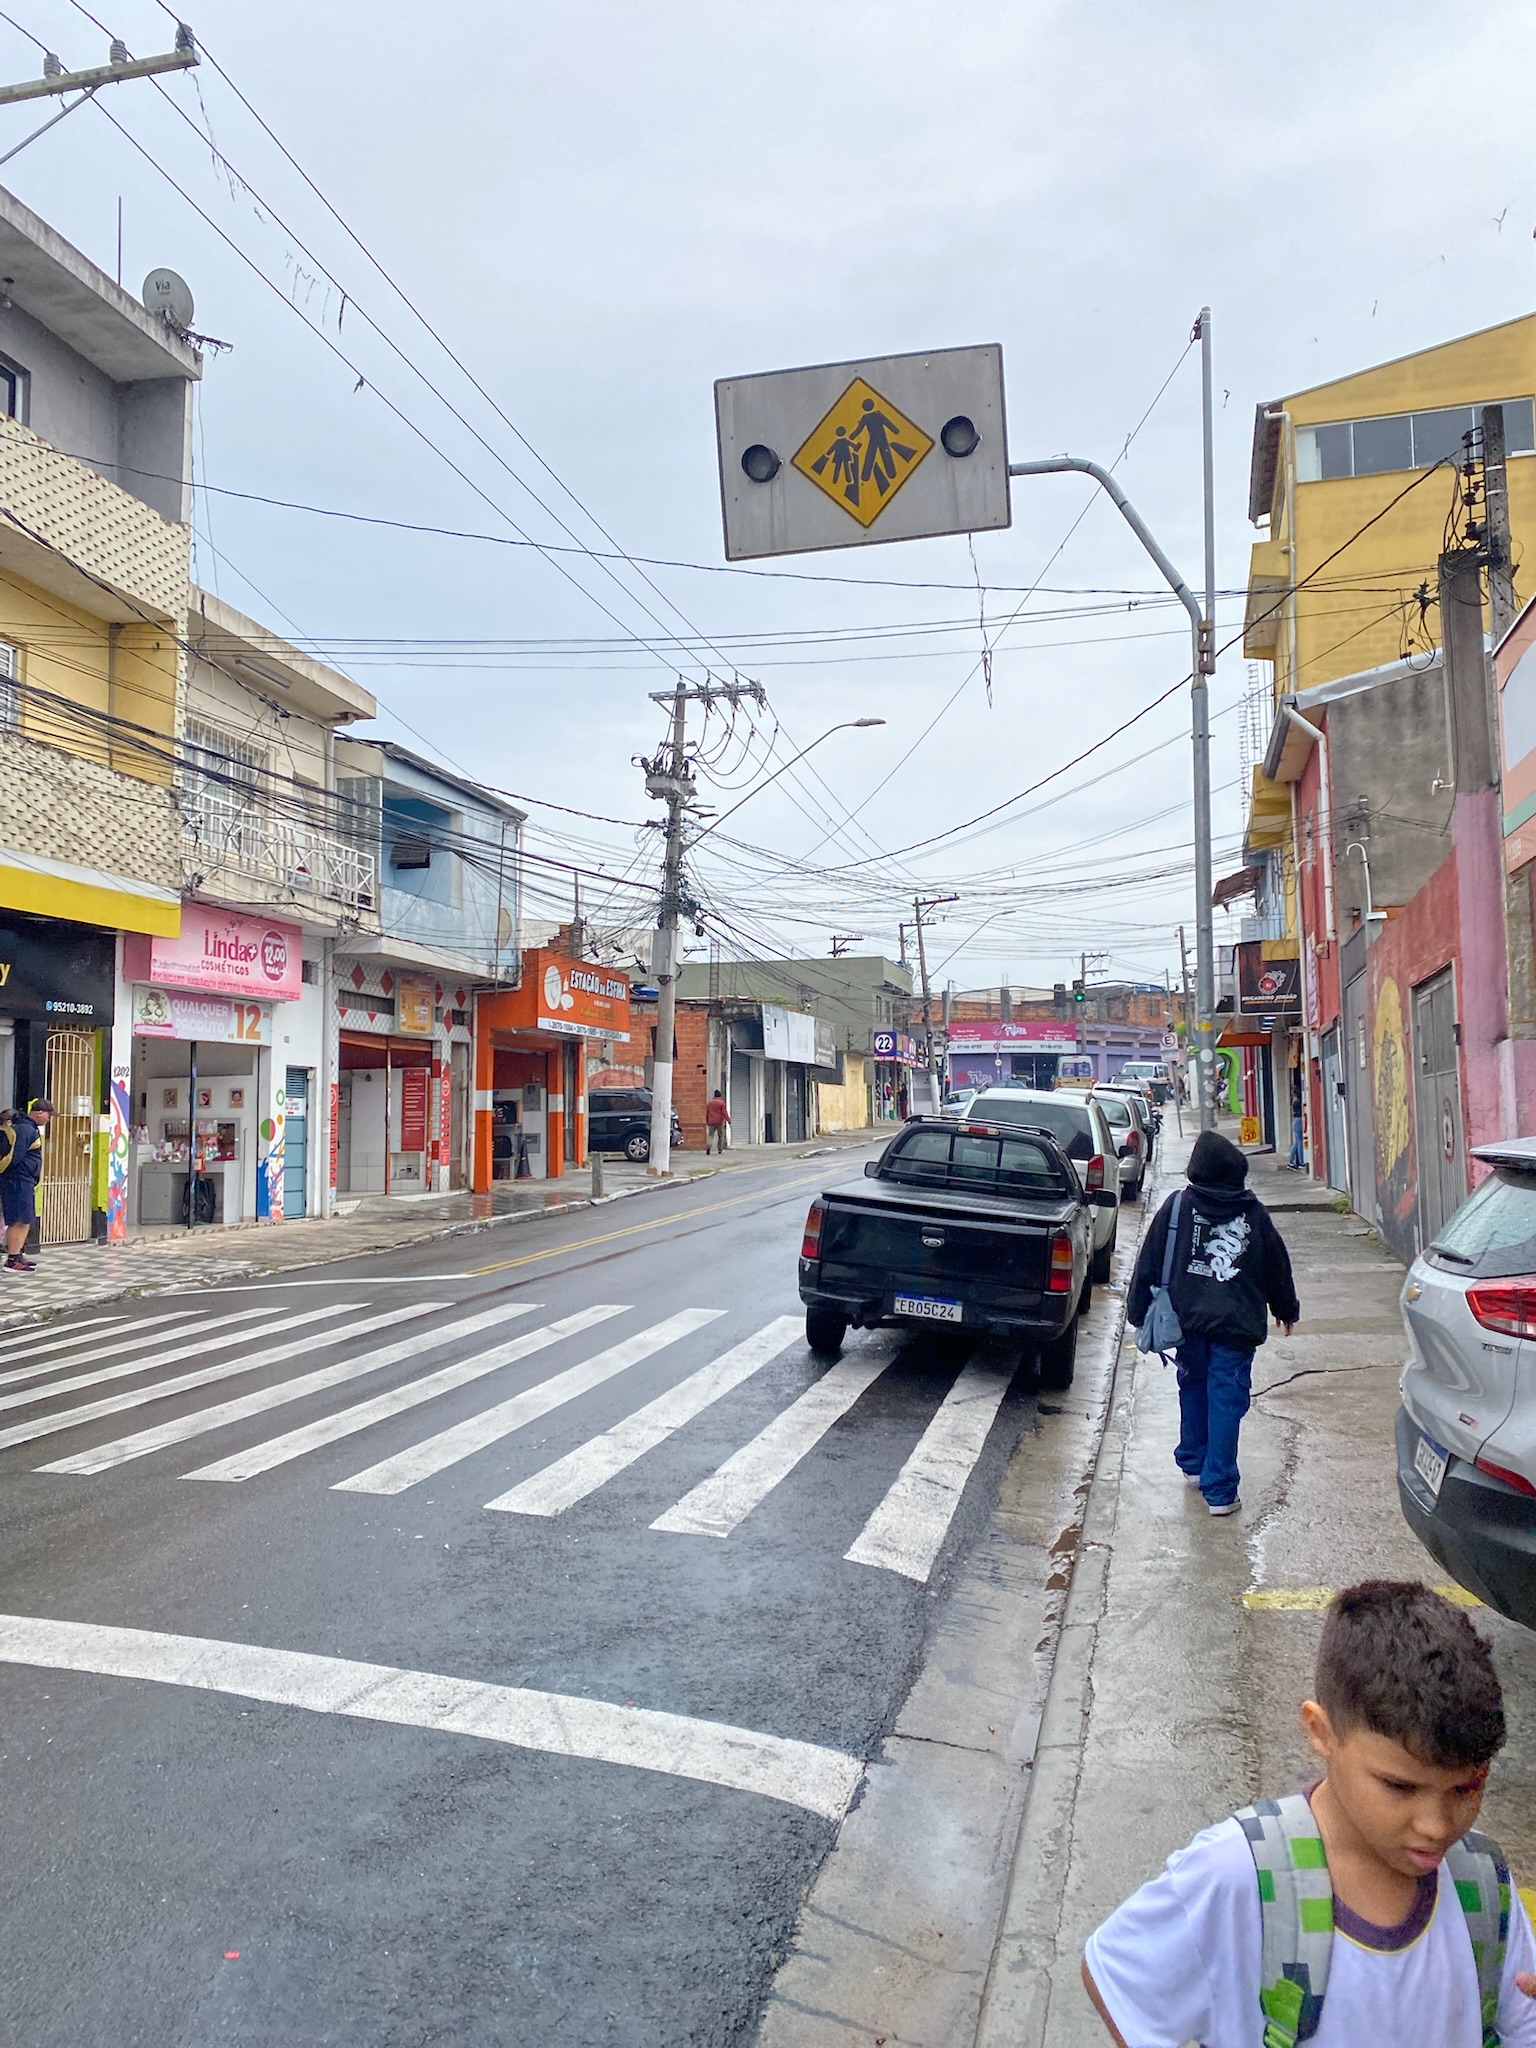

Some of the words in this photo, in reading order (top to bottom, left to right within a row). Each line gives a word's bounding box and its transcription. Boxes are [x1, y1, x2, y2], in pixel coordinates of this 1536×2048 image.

[201, 959, 250, 976] COSMÉTICOS
[570, 969, 600, 997] ESTAÇÃO
[605, 978, 627, 1001] ESFIHA
[53, 1001, 94, 1015] 95210-3892
[172, 999, 229, 1019] QUALQUER
[175, 1017, 226, 1033] PRODUTO
[234, 1003, 262, 1040] 12
[878, 1036, 890, 1050] 22
[1164, 1036, 1172, 1045] E
